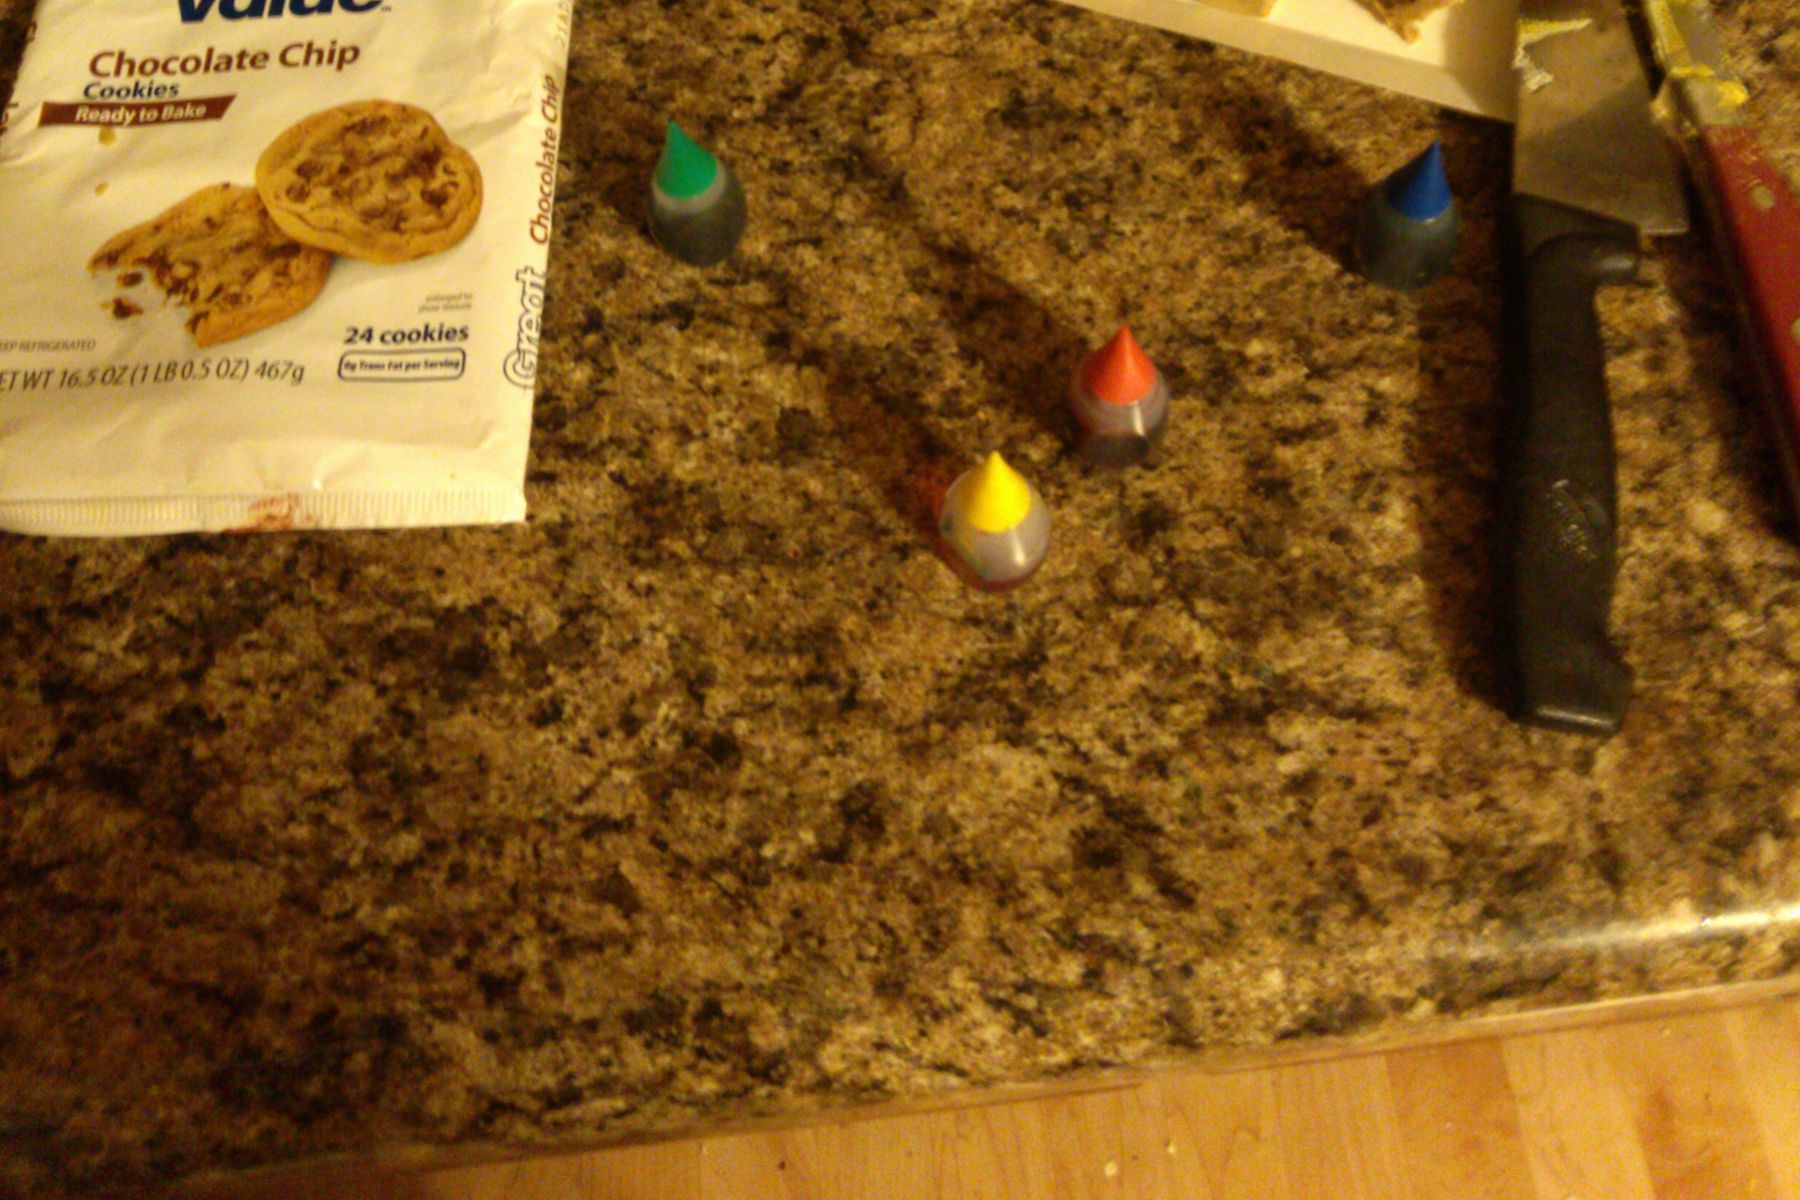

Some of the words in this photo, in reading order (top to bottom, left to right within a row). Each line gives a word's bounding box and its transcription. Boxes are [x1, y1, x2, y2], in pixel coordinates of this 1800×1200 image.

[89, 47, 270, 79] Chocolate
[278, 40, 361, 72] Chip
[83, 80, 180, 101] Cookies
[541, 74, 561, 125] Chip
[75, 104, 136, 127] Ready
[139, 104, 158, 122] to
[161, 101, 207, 120] Bake
[529, 124, 557, 246] Chocolate
[343, 326, 374, 345] 24
[379, 322, 470, 345] cookies
[502, 266, 547, 391] Great
[19, 339, 97, 352] REFRIGERATED
[23, 369, 55, 391] WT
[60, 368, 97, 389] 16.5
[101, 365, 131, 386] OZ
[130, 362, 150, 387] (1
[153, 361, 178, 383] LB
[181, 358, 210, 380] 0.5
[216, 357, 250, 382] OZ)
[255, 360, 305, 385] 467g
[359, 361, 386, 371] Trans
[388, 360, 404, 370] Fat
[405, 361, 421, 372] per
[424, 359, 460, 371] Serving
